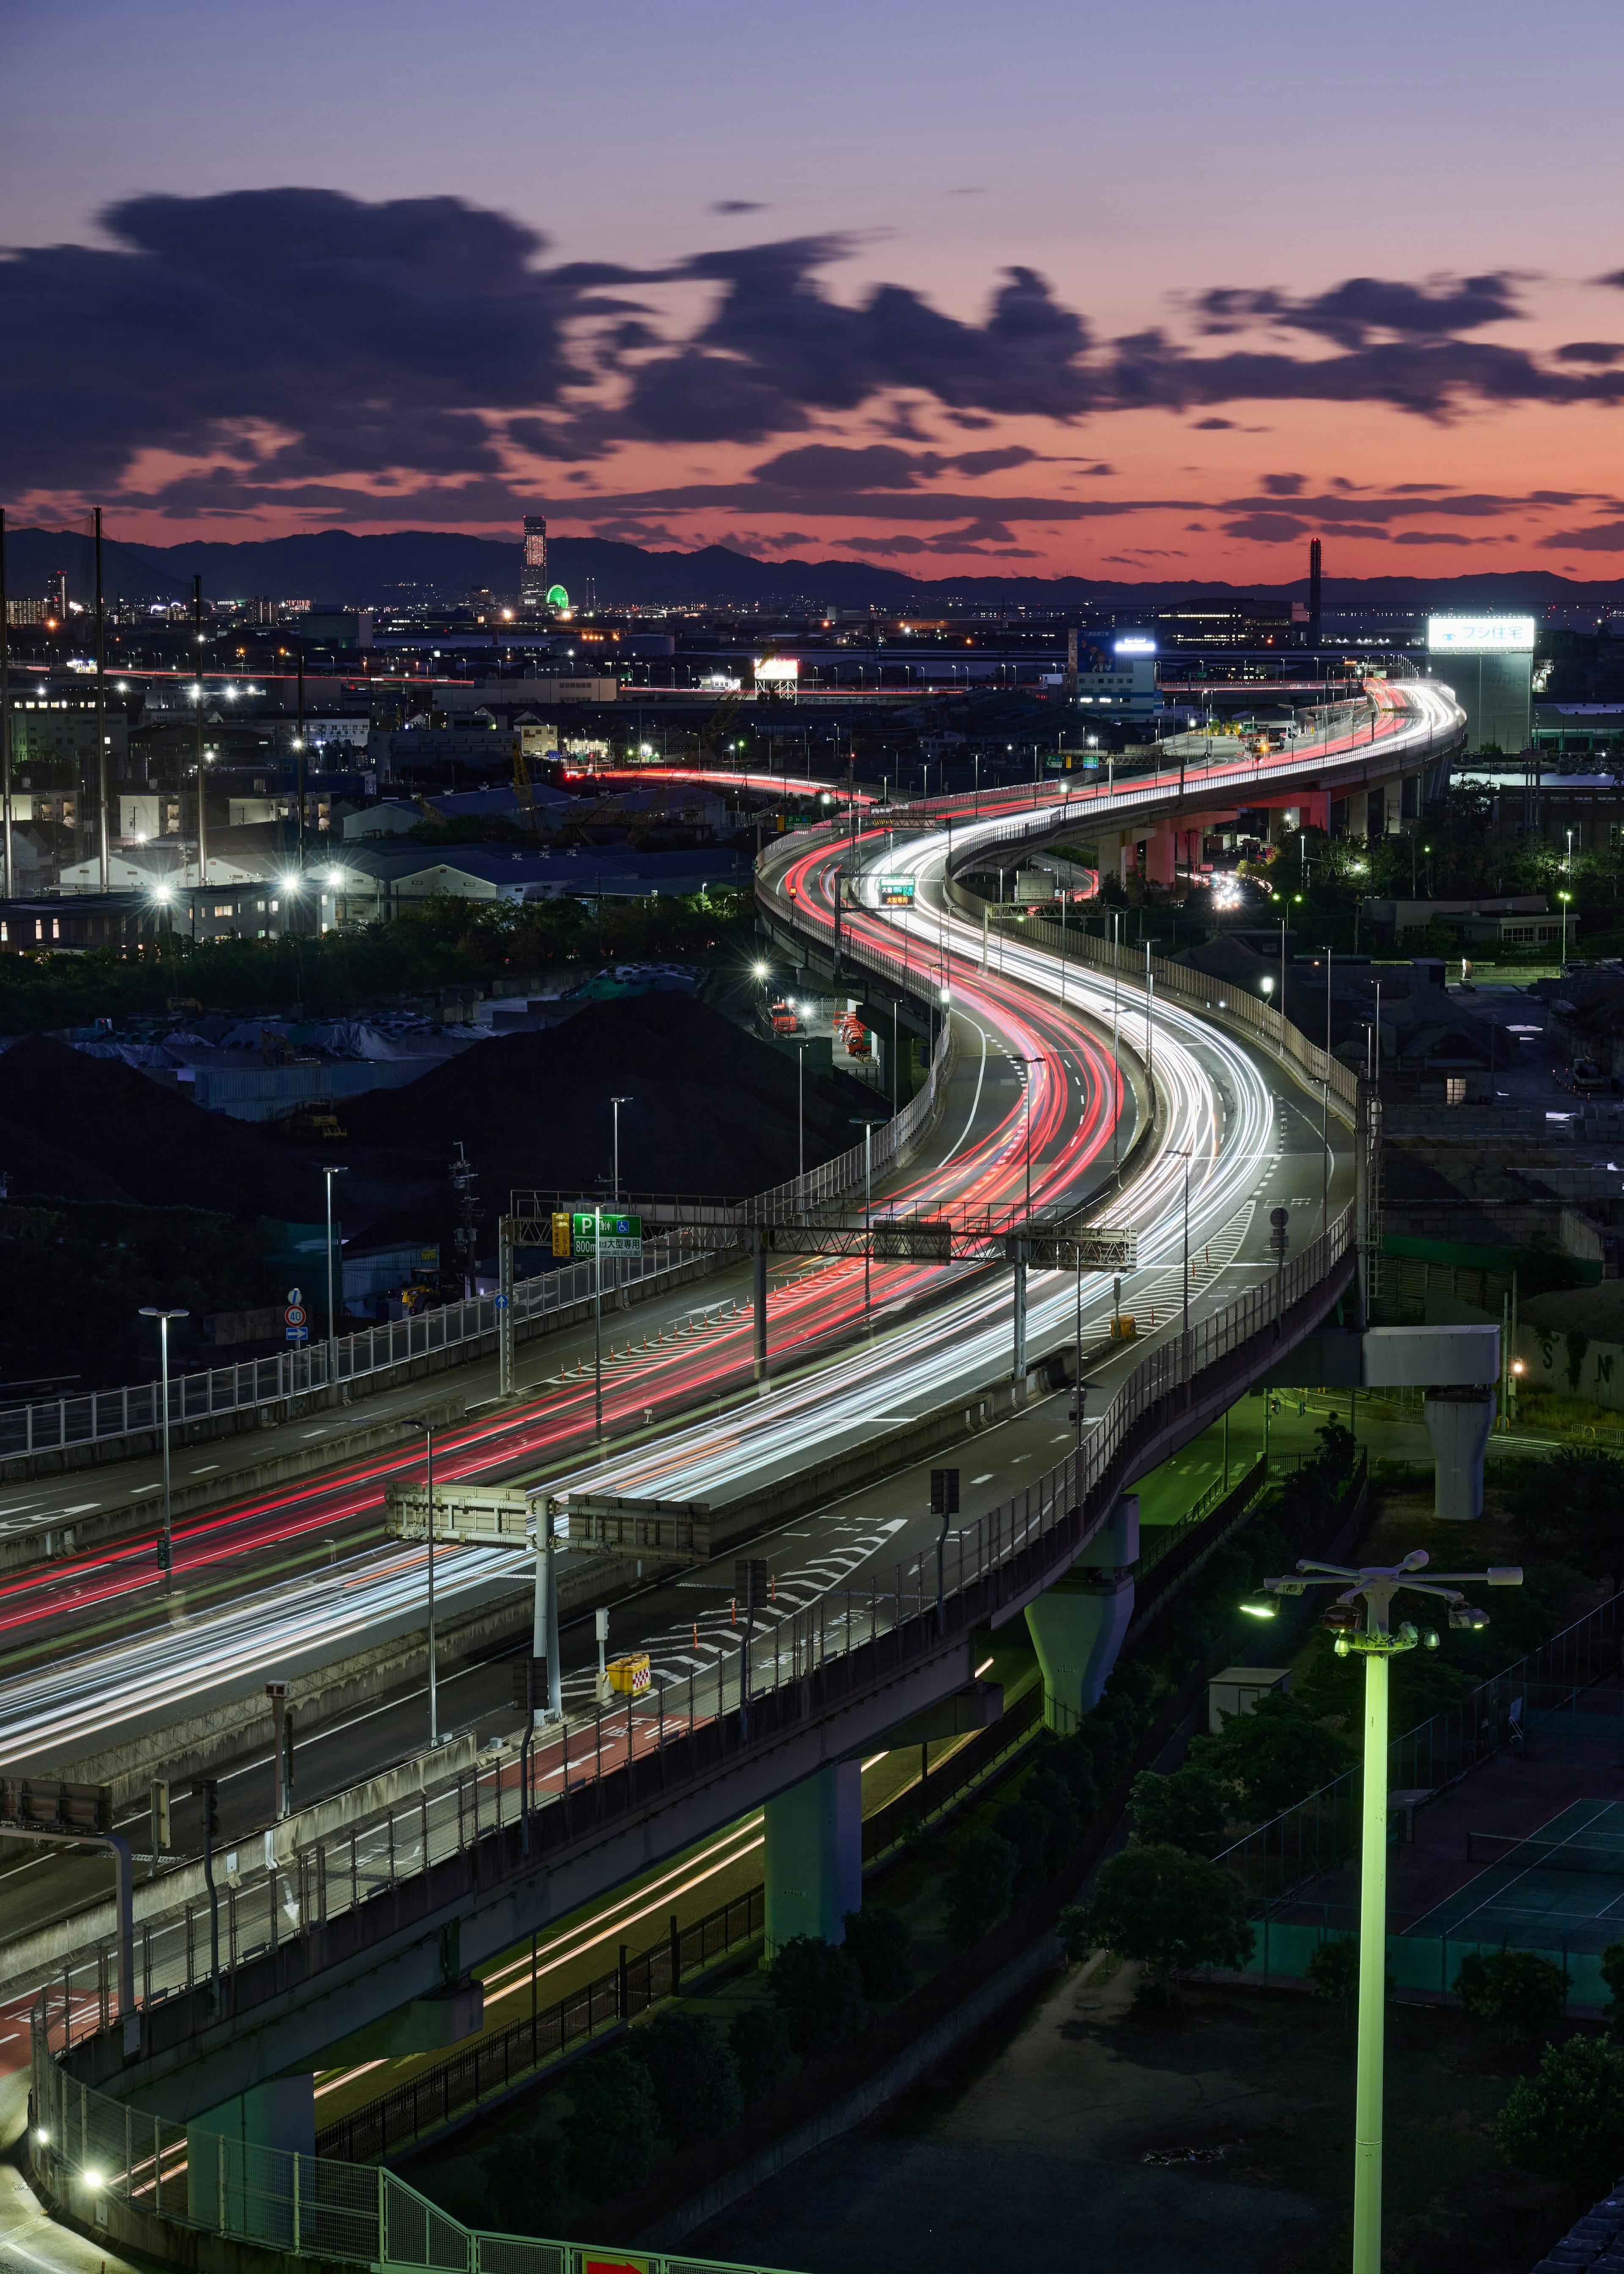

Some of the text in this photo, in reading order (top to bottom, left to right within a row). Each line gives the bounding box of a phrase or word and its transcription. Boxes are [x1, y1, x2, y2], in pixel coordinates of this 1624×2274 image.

[582, 1217, 593, 1234] P
[576, 1240, 596, 1253] 800m
[290, 1312, 301, 1321] 40
